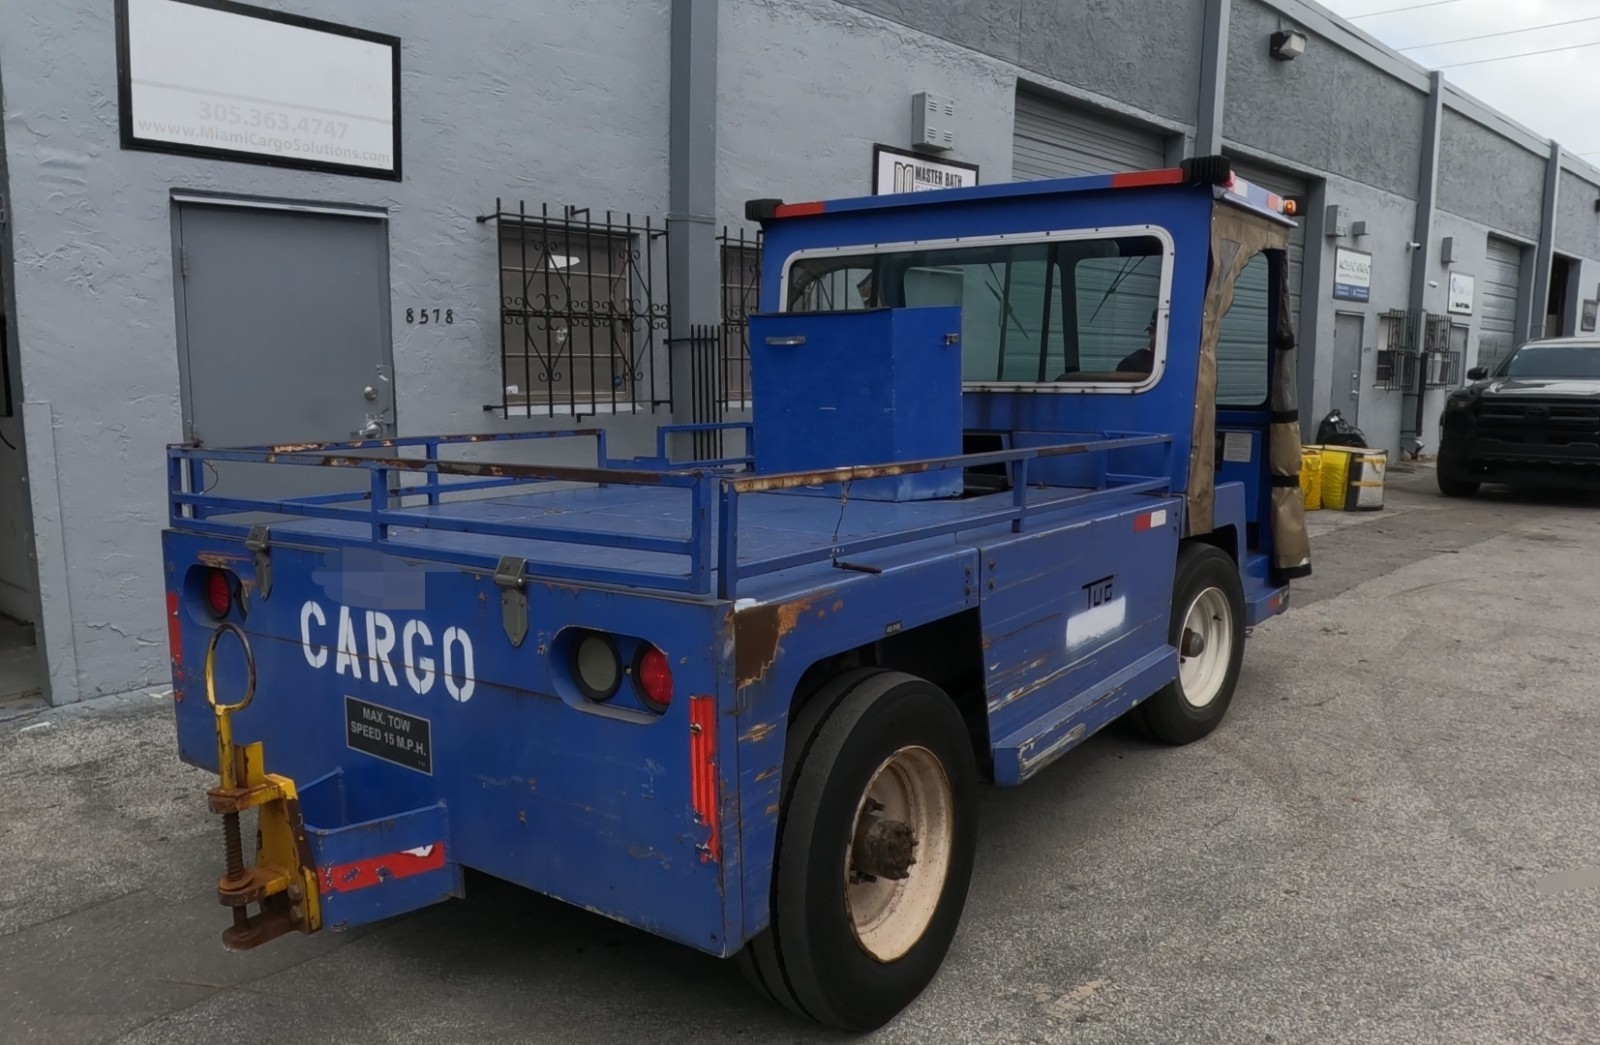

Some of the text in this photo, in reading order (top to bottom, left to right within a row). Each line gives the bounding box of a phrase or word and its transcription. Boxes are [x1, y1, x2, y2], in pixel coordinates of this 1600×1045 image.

[199, 100, 349, 140] 305.363.4747
[915, 165, 943, 185] MASTER
[406, 307, 453, 324] 8578
[300, 600, 475, 703] CARGO
[362, 706, 411, 733] MAX. TOW
[350, 720, 427, 756] SPEED 15 M.P.H.
